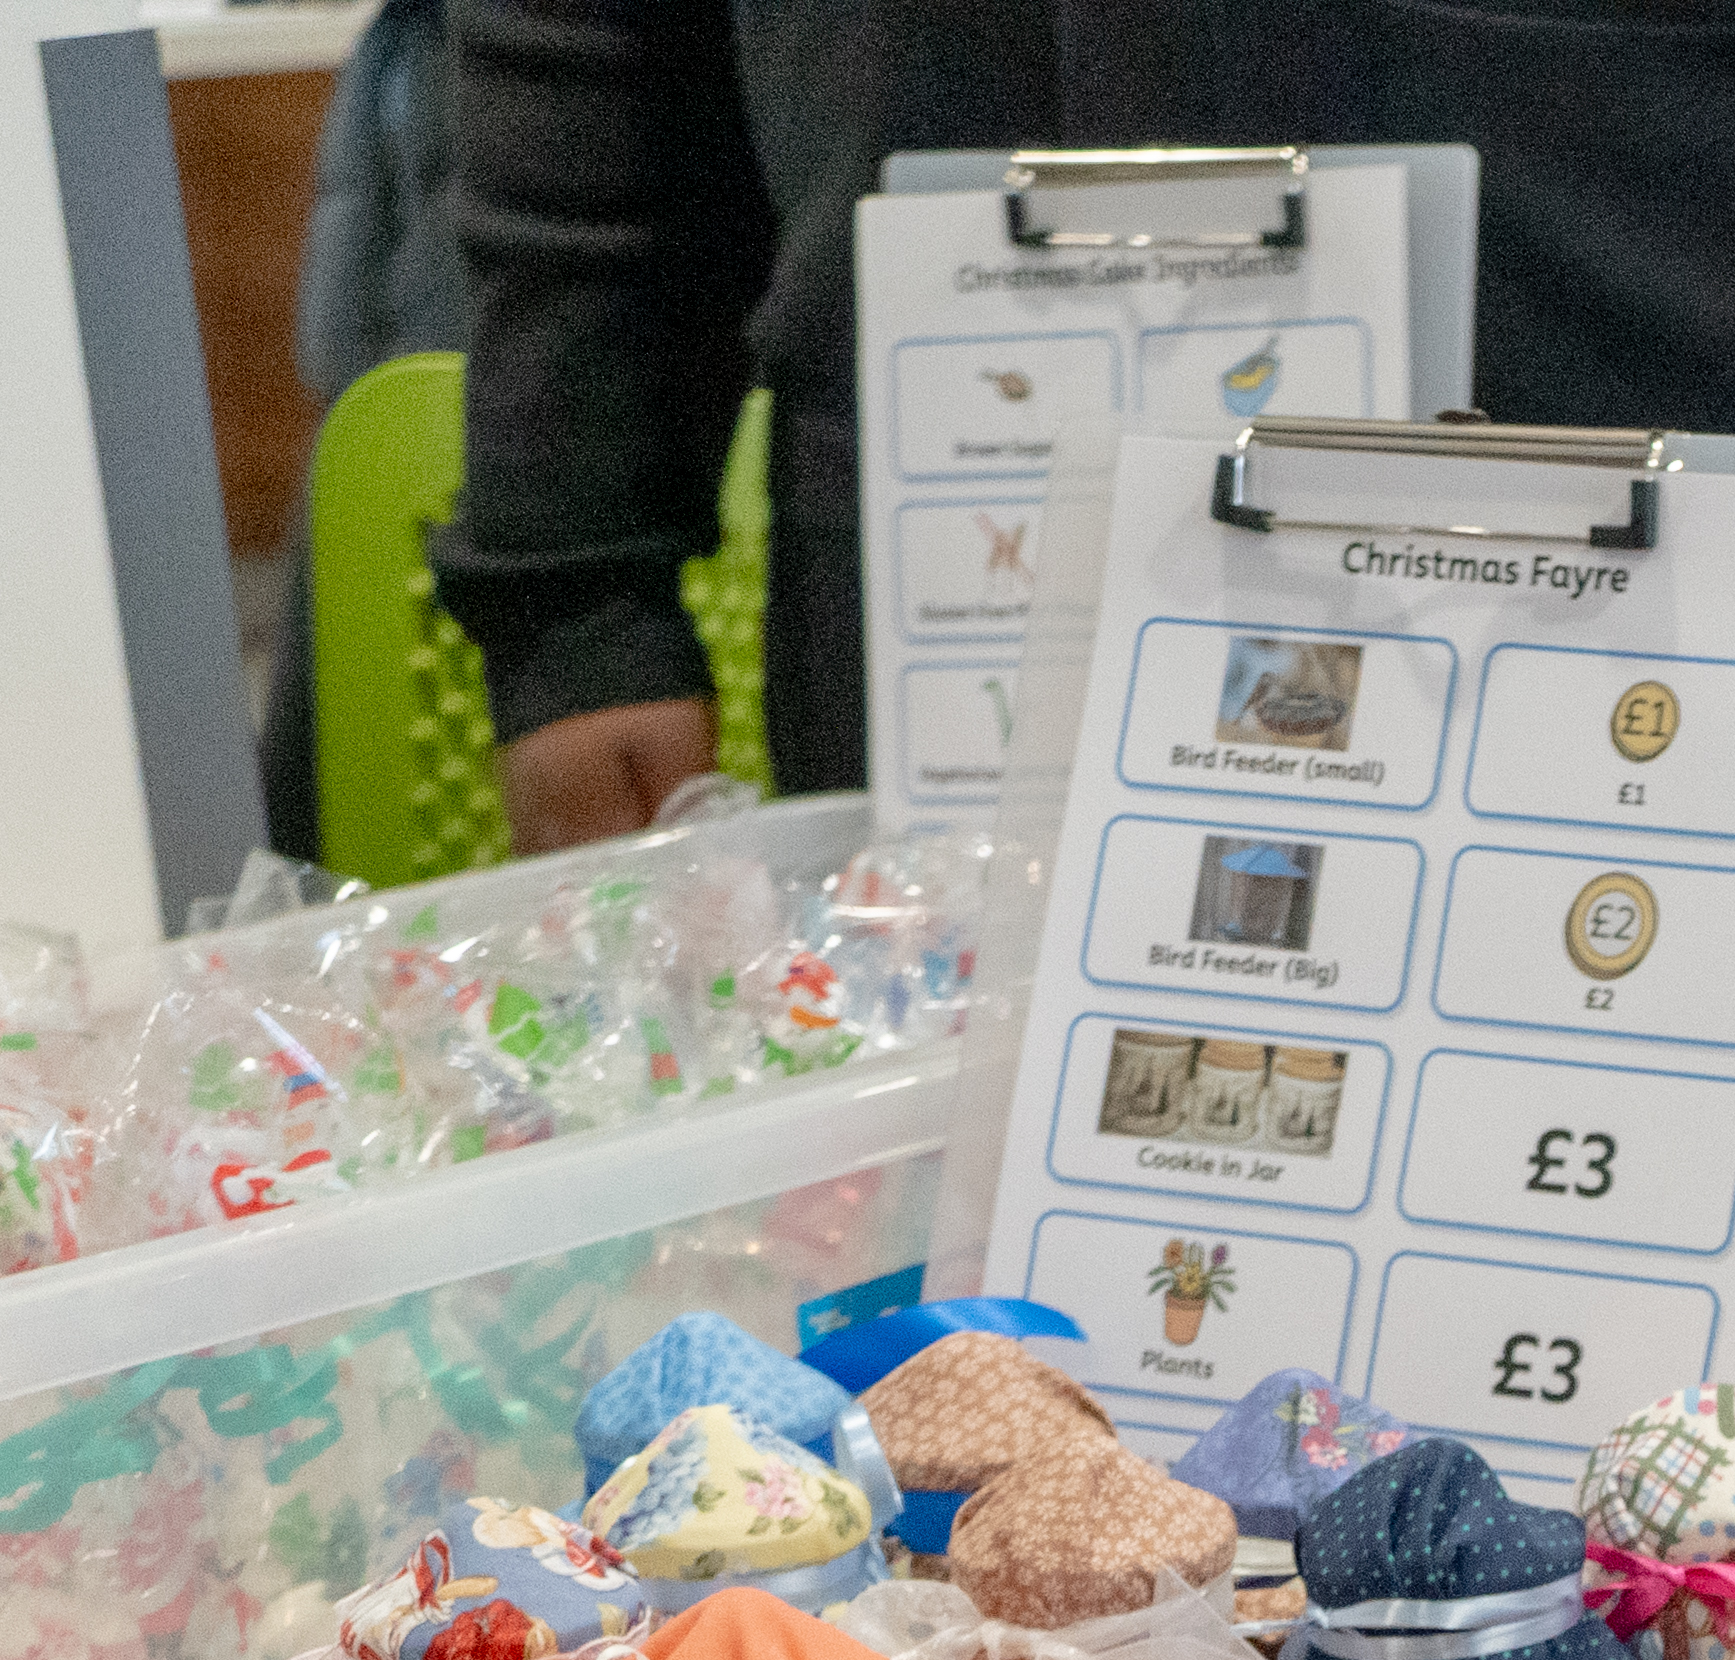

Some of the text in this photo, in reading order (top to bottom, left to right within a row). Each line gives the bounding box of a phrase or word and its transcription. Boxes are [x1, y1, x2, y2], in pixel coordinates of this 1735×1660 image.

[1342, 541, 1630, 601] Christmas Fayre
[1619, 700, 1669, 739] £1
[1170, 745, 1385, 786] Bird Feeder (small)
[1617, 783, 1647, 807] £1
[1588, 905, 1636, 942] £2
[1147, 944, 1339, 987] Bird Feeder (Big)
[1586, 988, 1614, 1011] £2
[1137, 1145, 1285, 1184] Cookie in Jar
[1526, 1128, 1618, 1199] £3
[1140, 1350, 1215, 1380] Plants
[1492, 1335, 1584, 1404] £3
